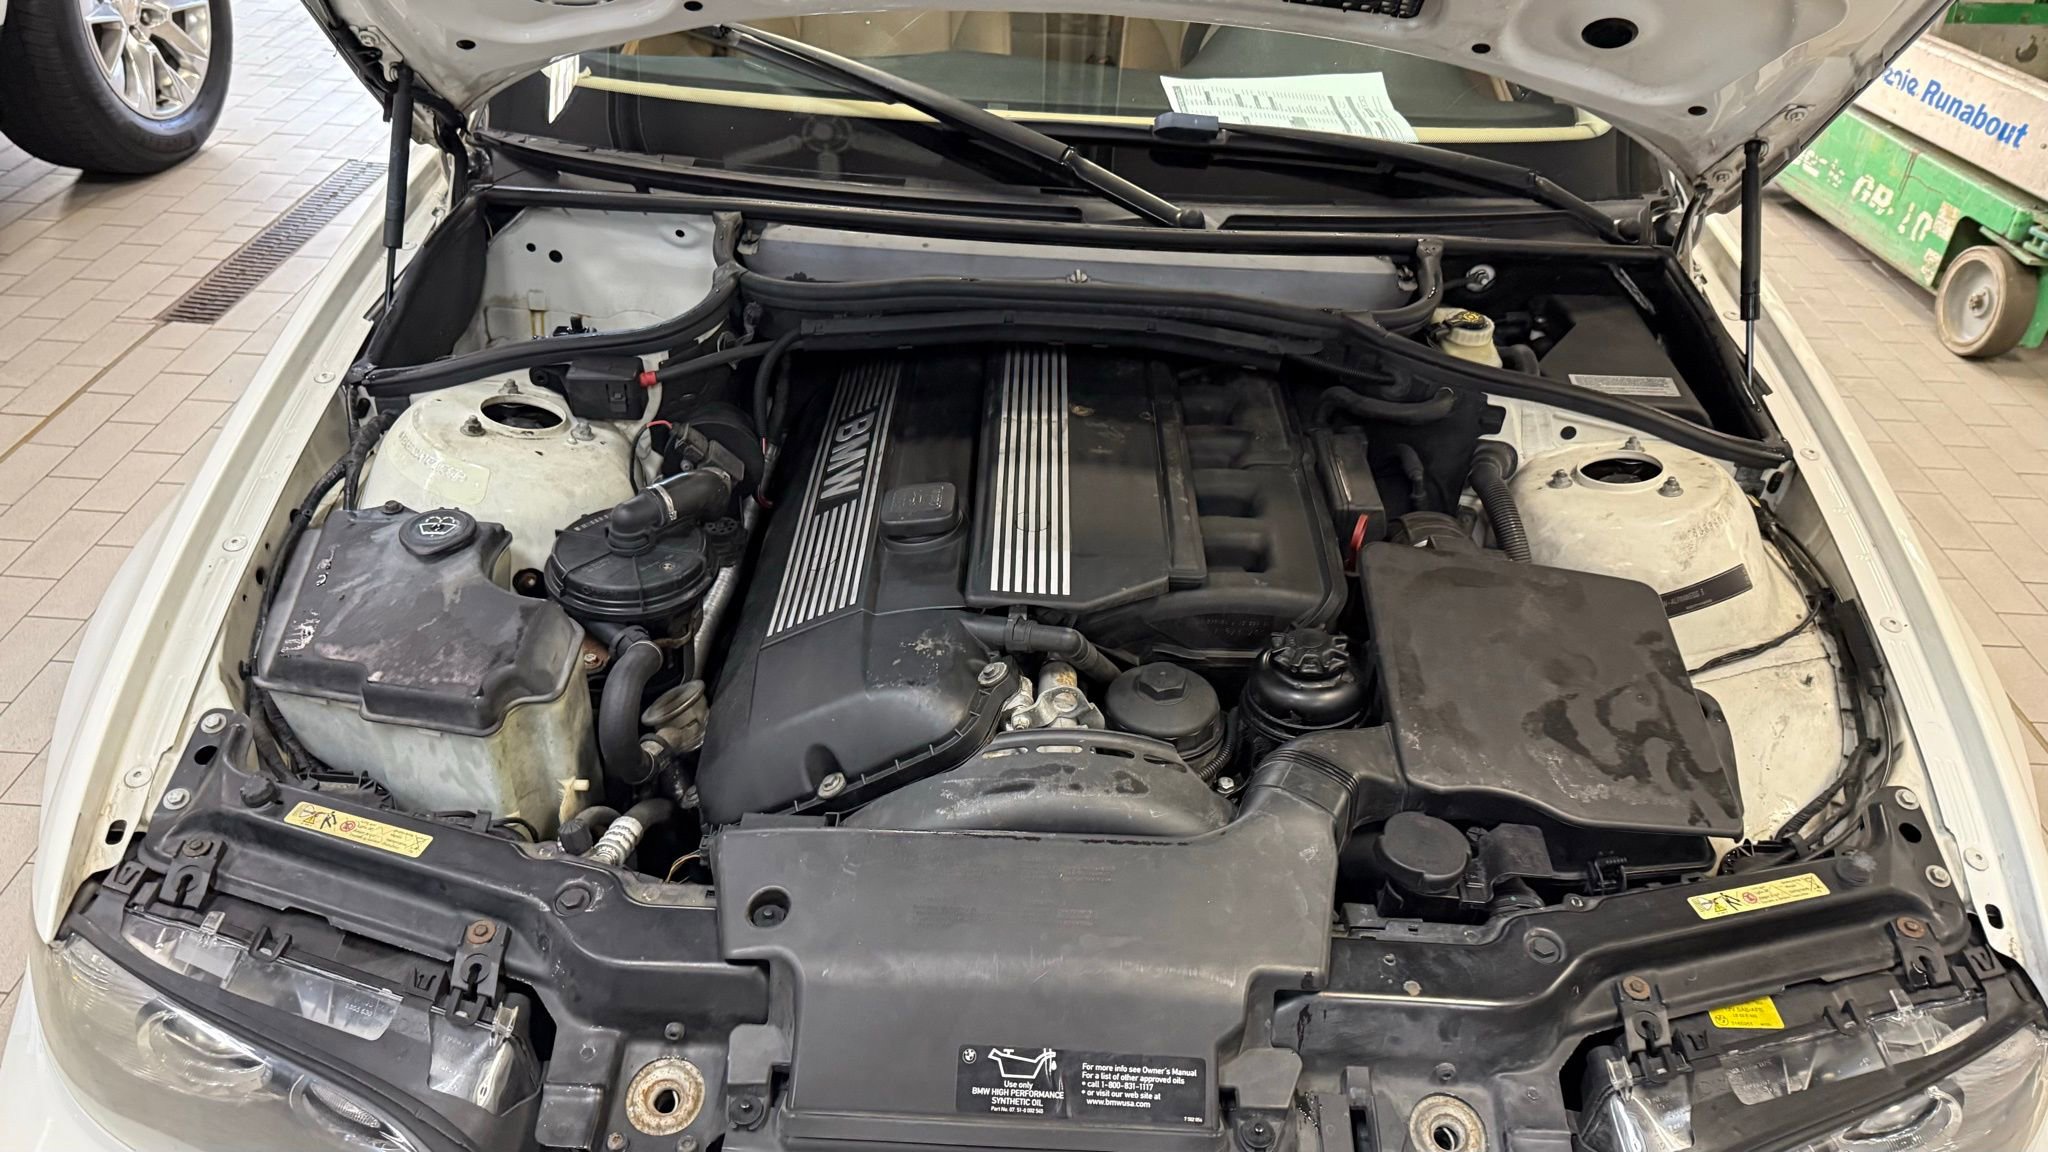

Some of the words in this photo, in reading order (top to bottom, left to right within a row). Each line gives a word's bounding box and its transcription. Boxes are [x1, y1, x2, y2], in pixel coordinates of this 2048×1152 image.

[1920, 79, 2029, 148] Runabout
[820, 412, 876, 500] BMW
[1114, 1064, 1127, 1073] info
[1171, 1068, 1197, 1077] Manual
[1082, 1071, 1094, 1079] For
[1100, 1072, 1111, 1080] list
[1120, 1073, 1139, 1081] other
[1140, 1075, 1171, 1084] approved
[1172, 1077, 1185, 1085] oils
[1004, 1080, 1018, 1088] Use
[1019, 1081, 1033, 1090] only
[1101, 1081, 1154, 1091] 1-800-831-1117
[972, 1087, 990, 1095] BMW
[991, 1088, 1010, 1096] HIGH
[1010, 1089, 1064, 1099] PERFORMANCE
[1096, 1089, 1110, 1097] visit
[1124, 1091, 1139, 1099] web
[1140, 1091, 1153, 1099] site
[991, 1097, 1030, 1106] SYNTHETIC
[1031, 1099, 1043, 1107] OIL
[1086, 1098, 1151, 1108] www.bmwusa.com
